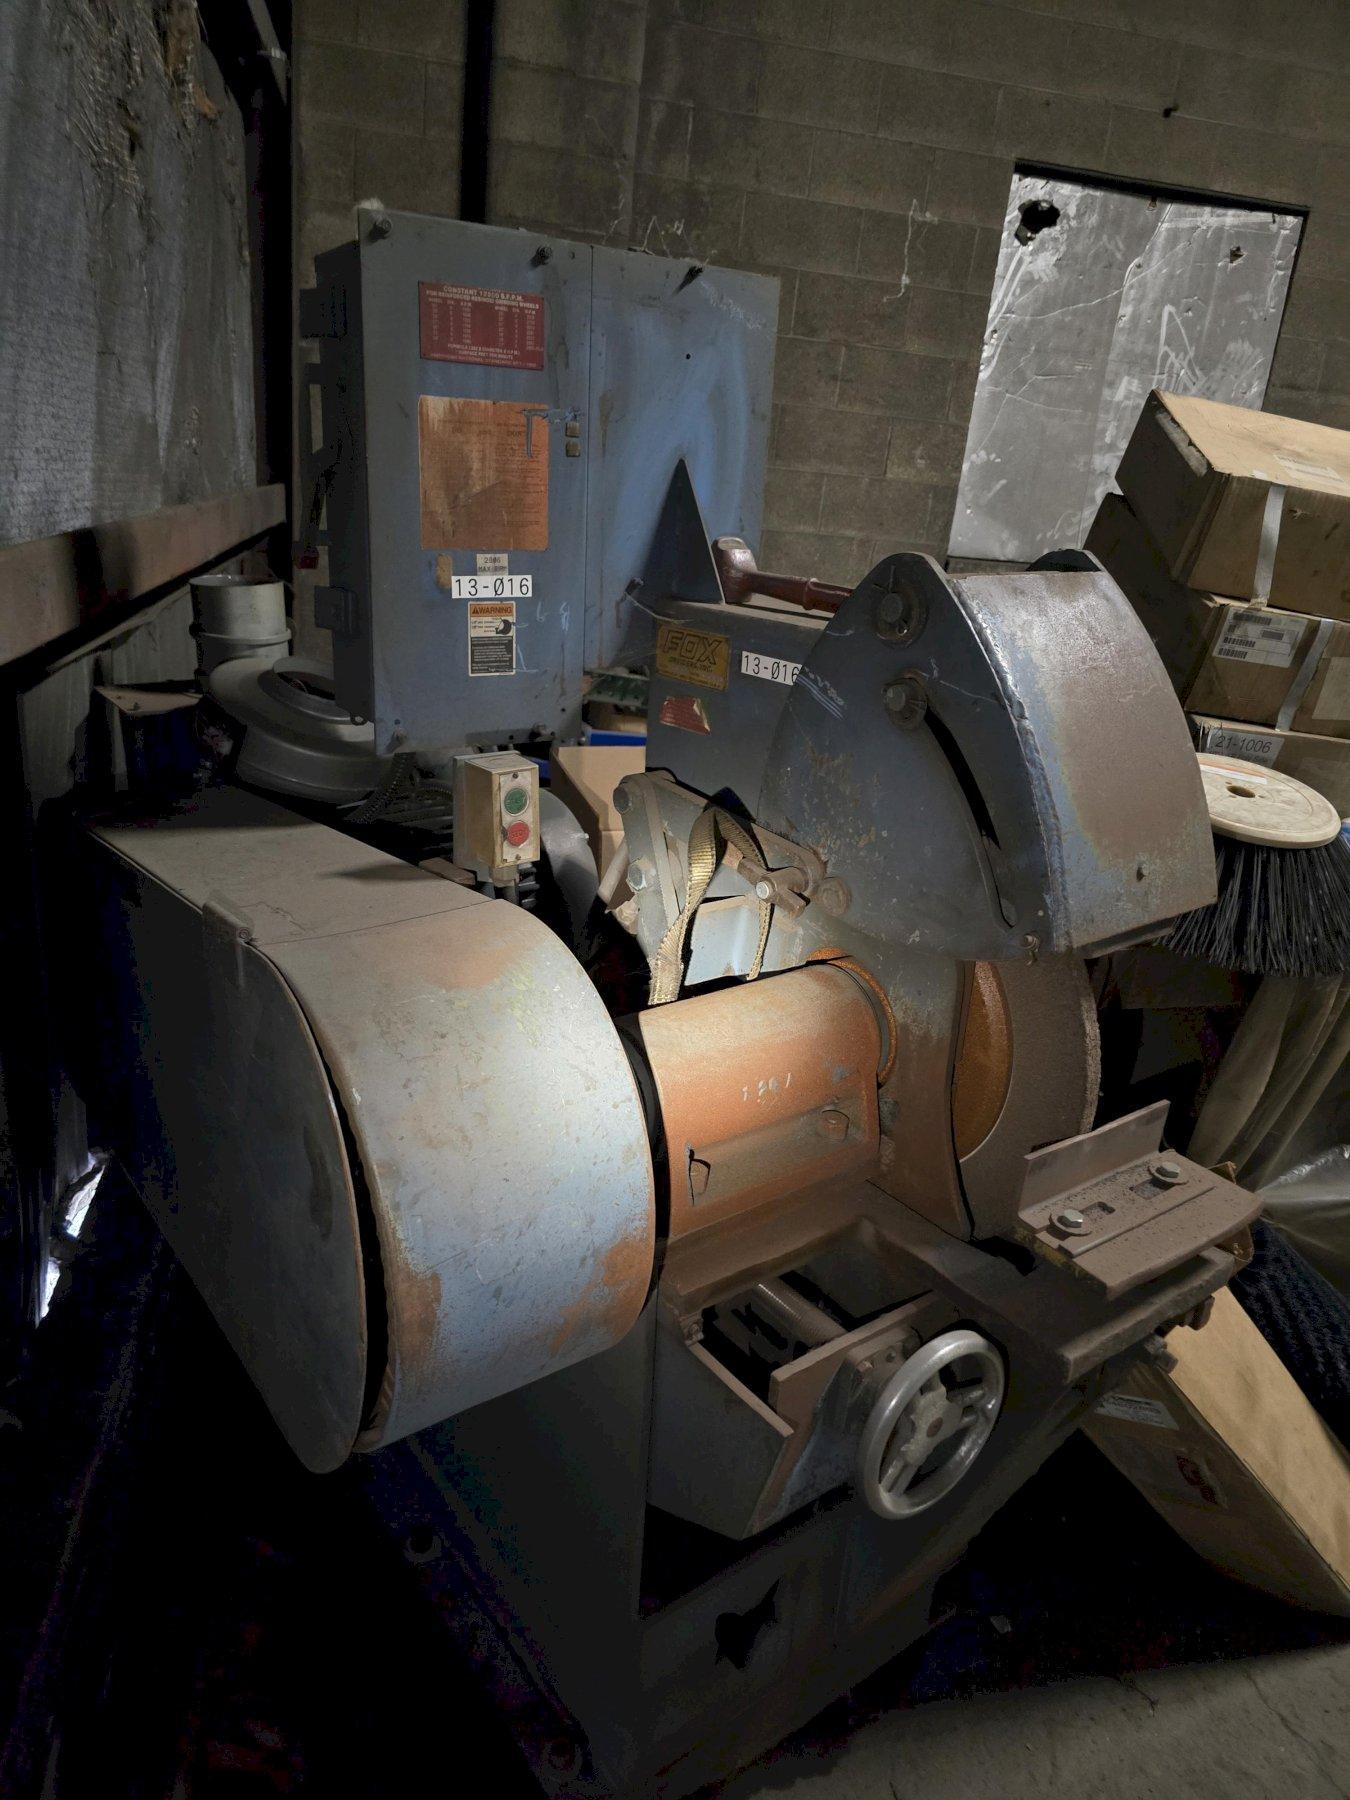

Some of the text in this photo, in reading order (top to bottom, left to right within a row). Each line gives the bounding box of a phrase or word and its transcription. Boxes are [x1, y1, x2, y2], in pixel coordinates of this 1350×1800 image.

[443, 285, 478, 296] CONSTANT
[519, 302, 539, 310] WHEELS
[478, 605, 512, 615] WARNING
[662, 629, 723, 666] FOX
[1214, 735, 1273, 754] 21-1006
